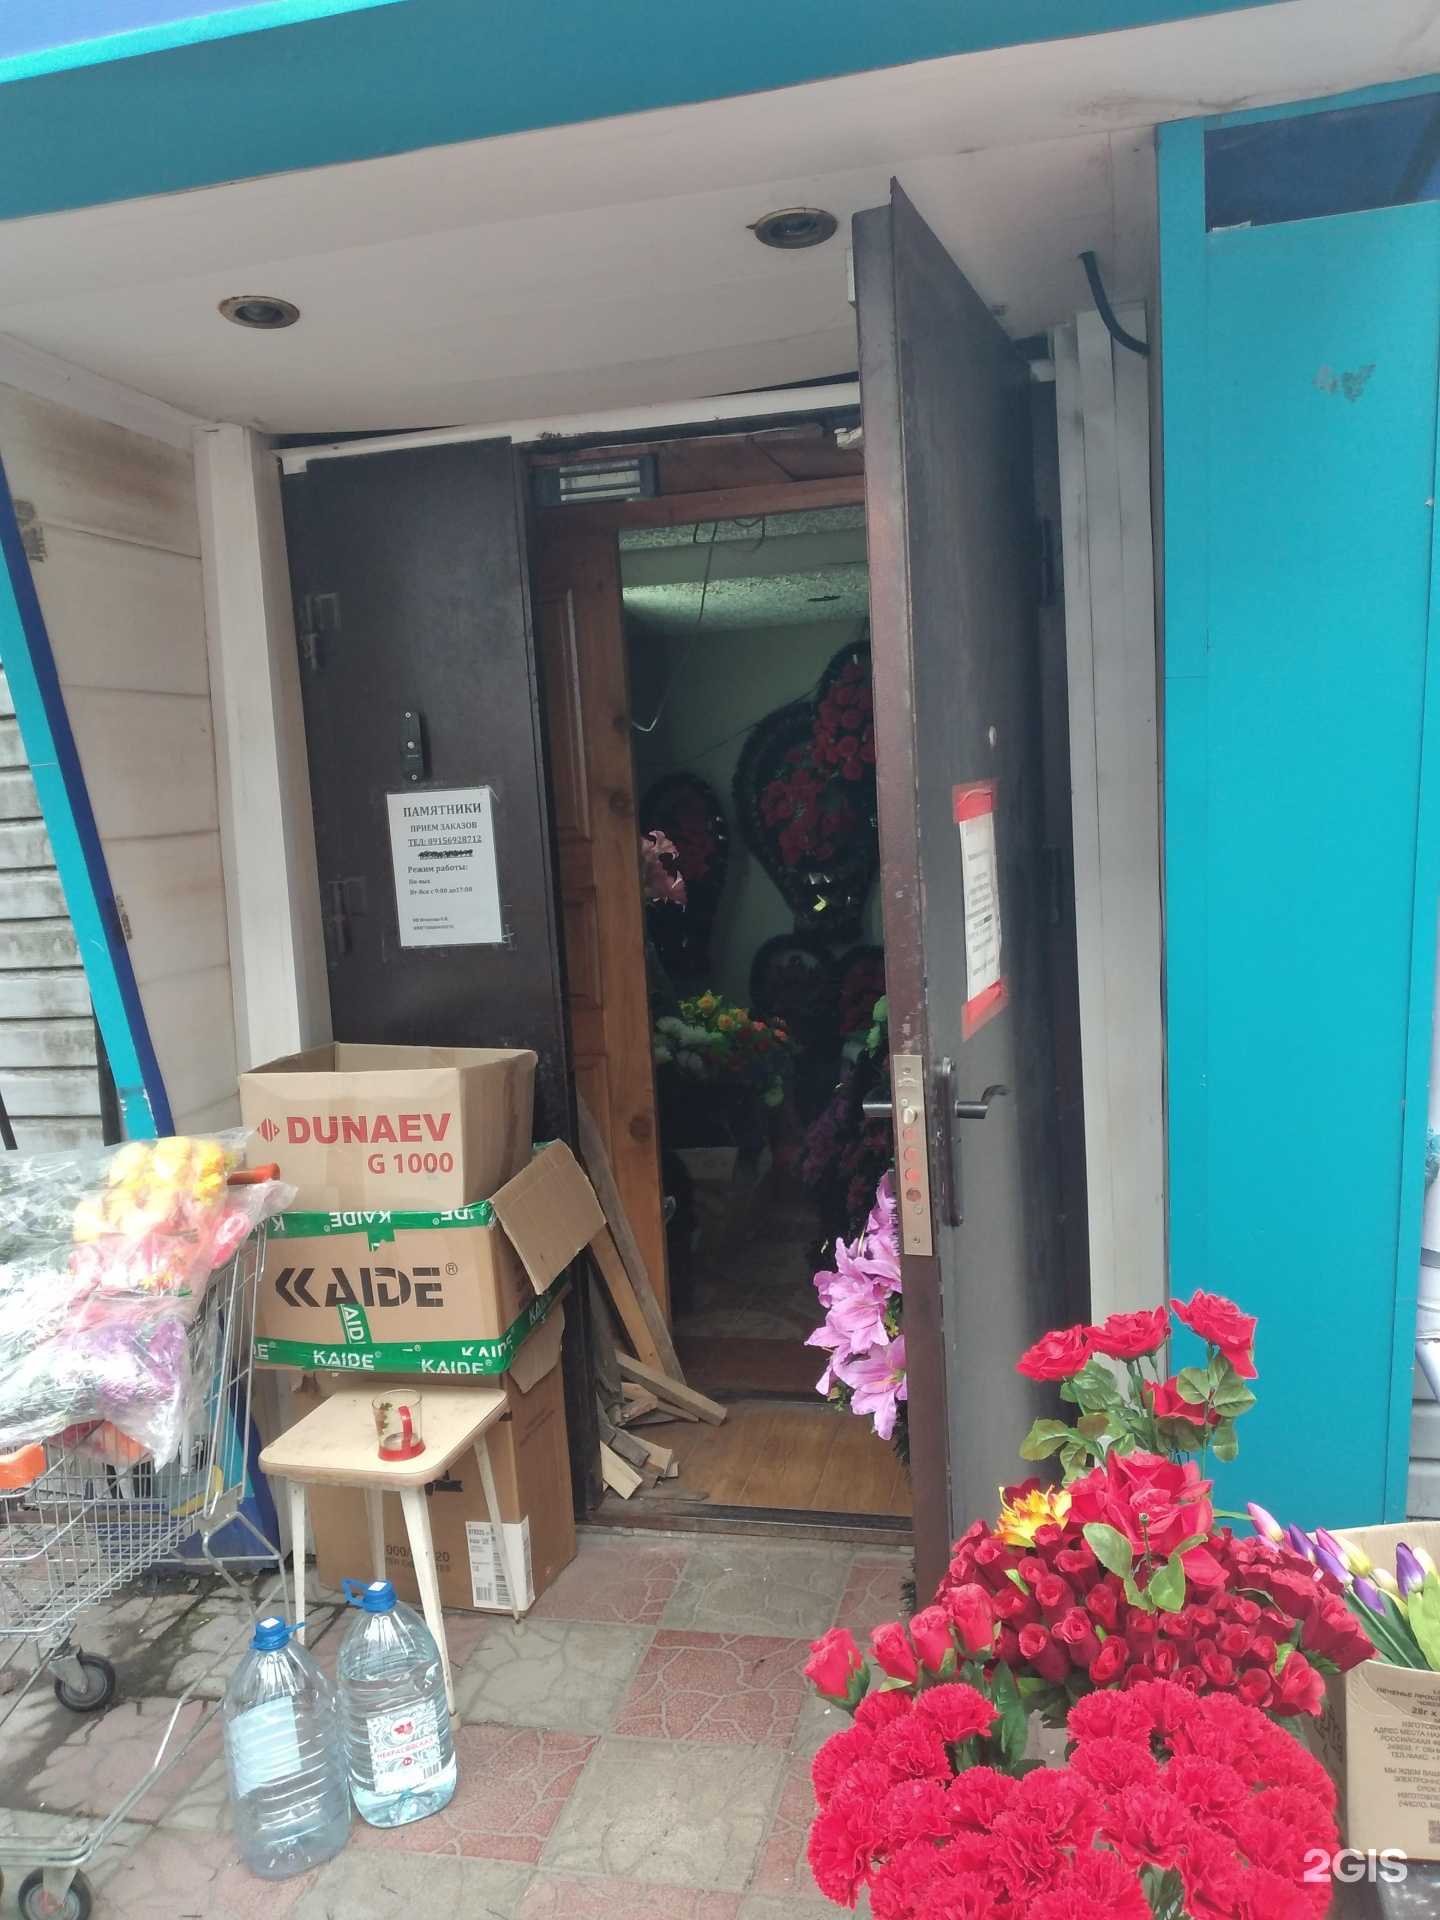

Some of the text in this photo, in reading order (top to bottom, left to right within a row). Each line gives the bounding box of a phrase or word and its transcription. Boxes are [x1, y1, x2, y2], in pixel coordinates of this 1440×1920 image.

[403, 802, 482, 818] ПАМЯТНИКИ
[410, 821, 478, 833] ПРИЕМ ЗАКАЗОВ
[407, 865, 435, 874] Режим
[287, 1112, 451, 1144] DUNAEV
[367, 1151, 454, 1174] G 1000
